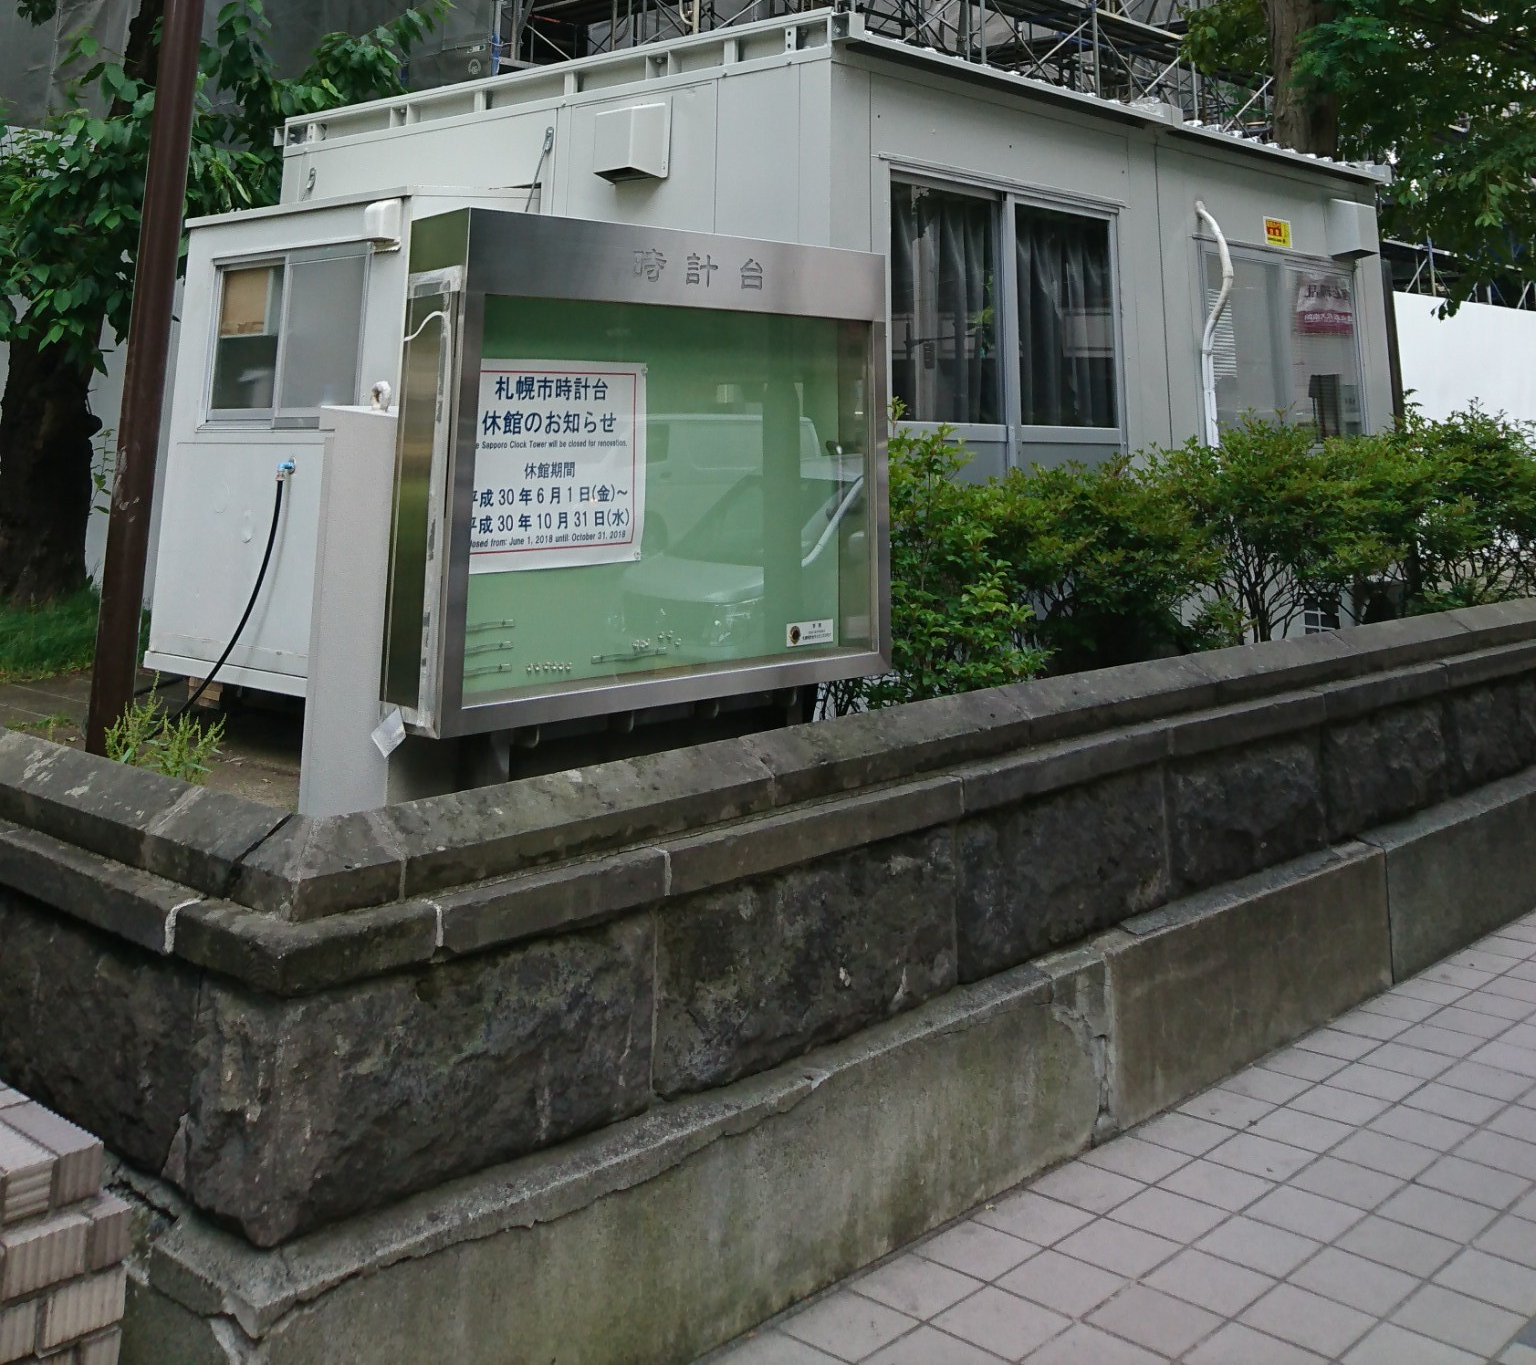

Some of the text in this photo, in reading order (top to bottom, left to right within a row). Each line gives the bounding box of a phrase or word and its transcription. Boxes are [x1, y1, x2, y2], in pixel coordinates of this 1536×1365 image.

[632, 248, 764, 291] 時計台
[495, 375, 609, 401] 札幌市時計台
[482, 410, 617, 436] 休館のお知らせ
[481, 440, 508, 450] Sapporo
[509, 440, 527, 450] Clock
[529, 439, 547, 449] Tower
[548, 439, 558, 448] will
[559, 439, 567, 448] be
[568, 438, 587, 448] closed
[588, 438, 596, 447] for
[524, 462, 576, 479] 休館期間
[470, 538, 489, 549] losed
[509, 536, 525, 546] June
[535, 534, 554, 544] 2018
[571, 532, 596, 542] October
[609, 529, 627, 539] 2018
